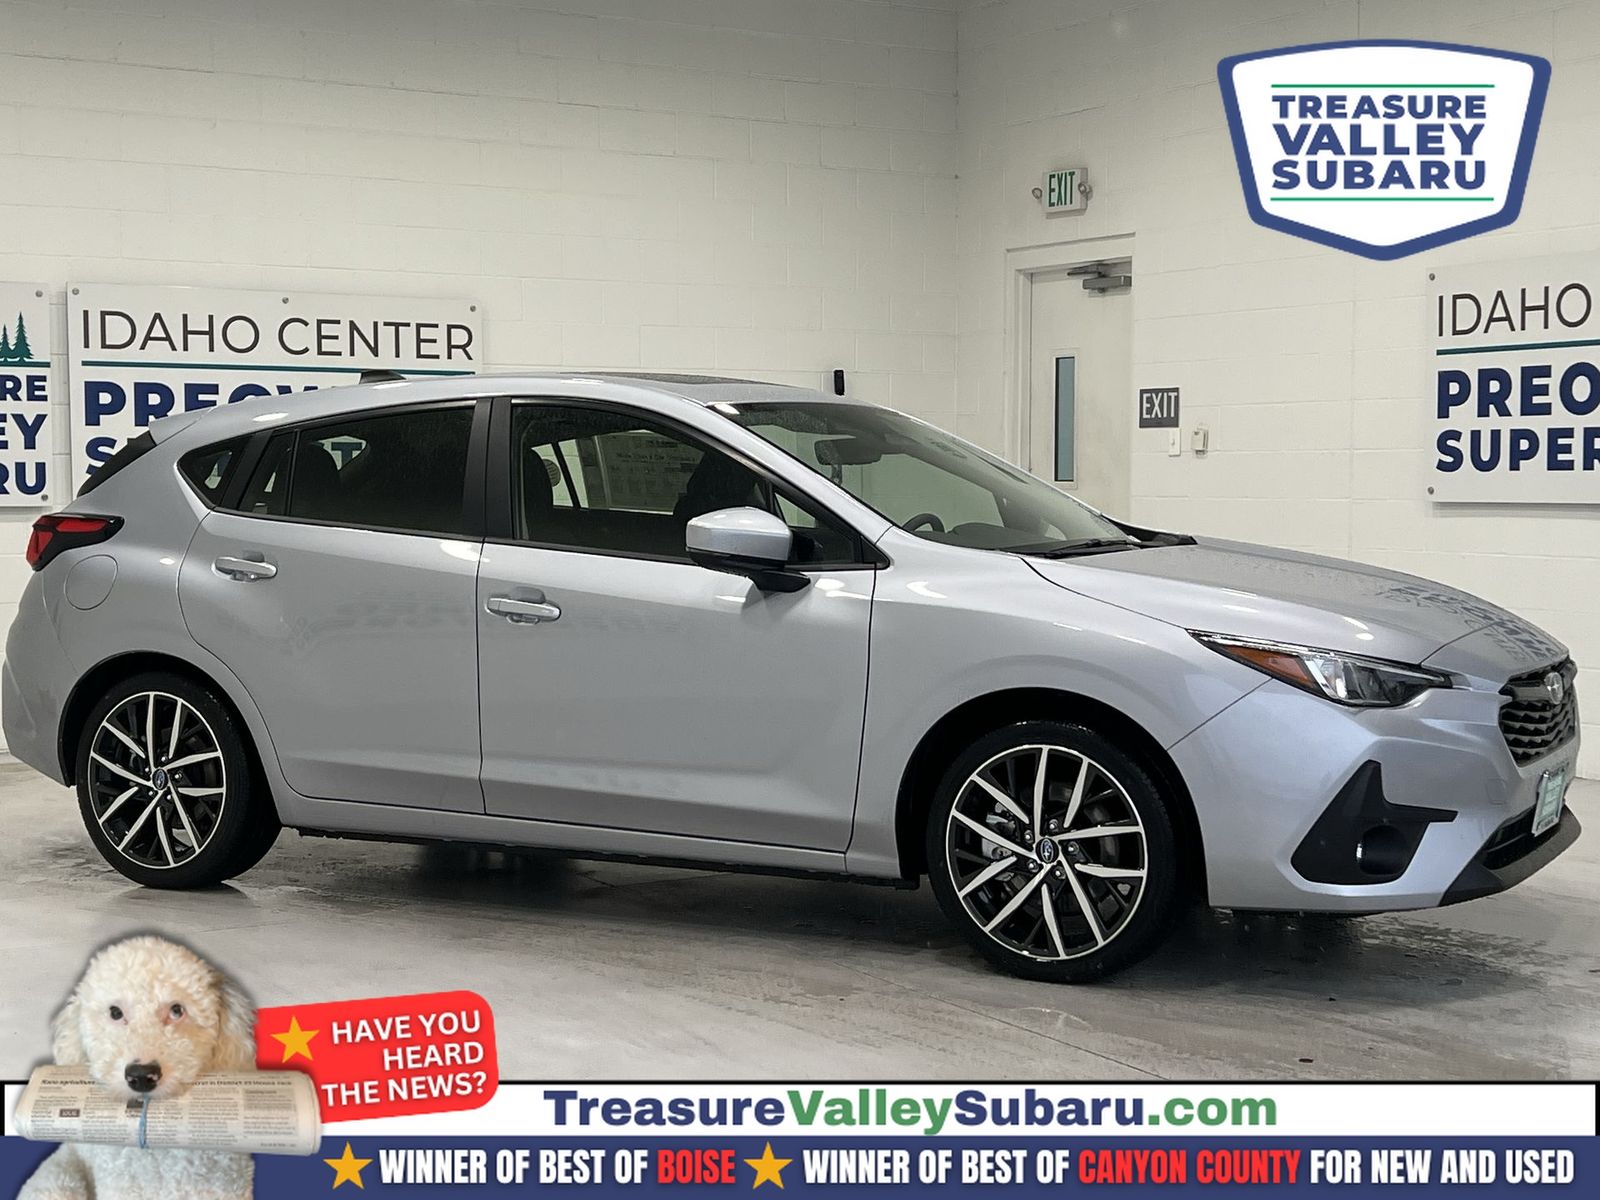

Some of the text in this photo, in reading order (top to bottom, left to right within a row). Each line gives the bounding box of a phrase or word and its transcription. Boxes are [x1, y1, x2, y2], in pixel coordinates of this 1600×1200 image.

[1048, 171, 1076, 207] EXIT
[1438, 283, 1592, 337] IDAHO
[82, 309, 474, 361] IDAHO CENTER
[1142, 392, 1178, 419] EXIT
